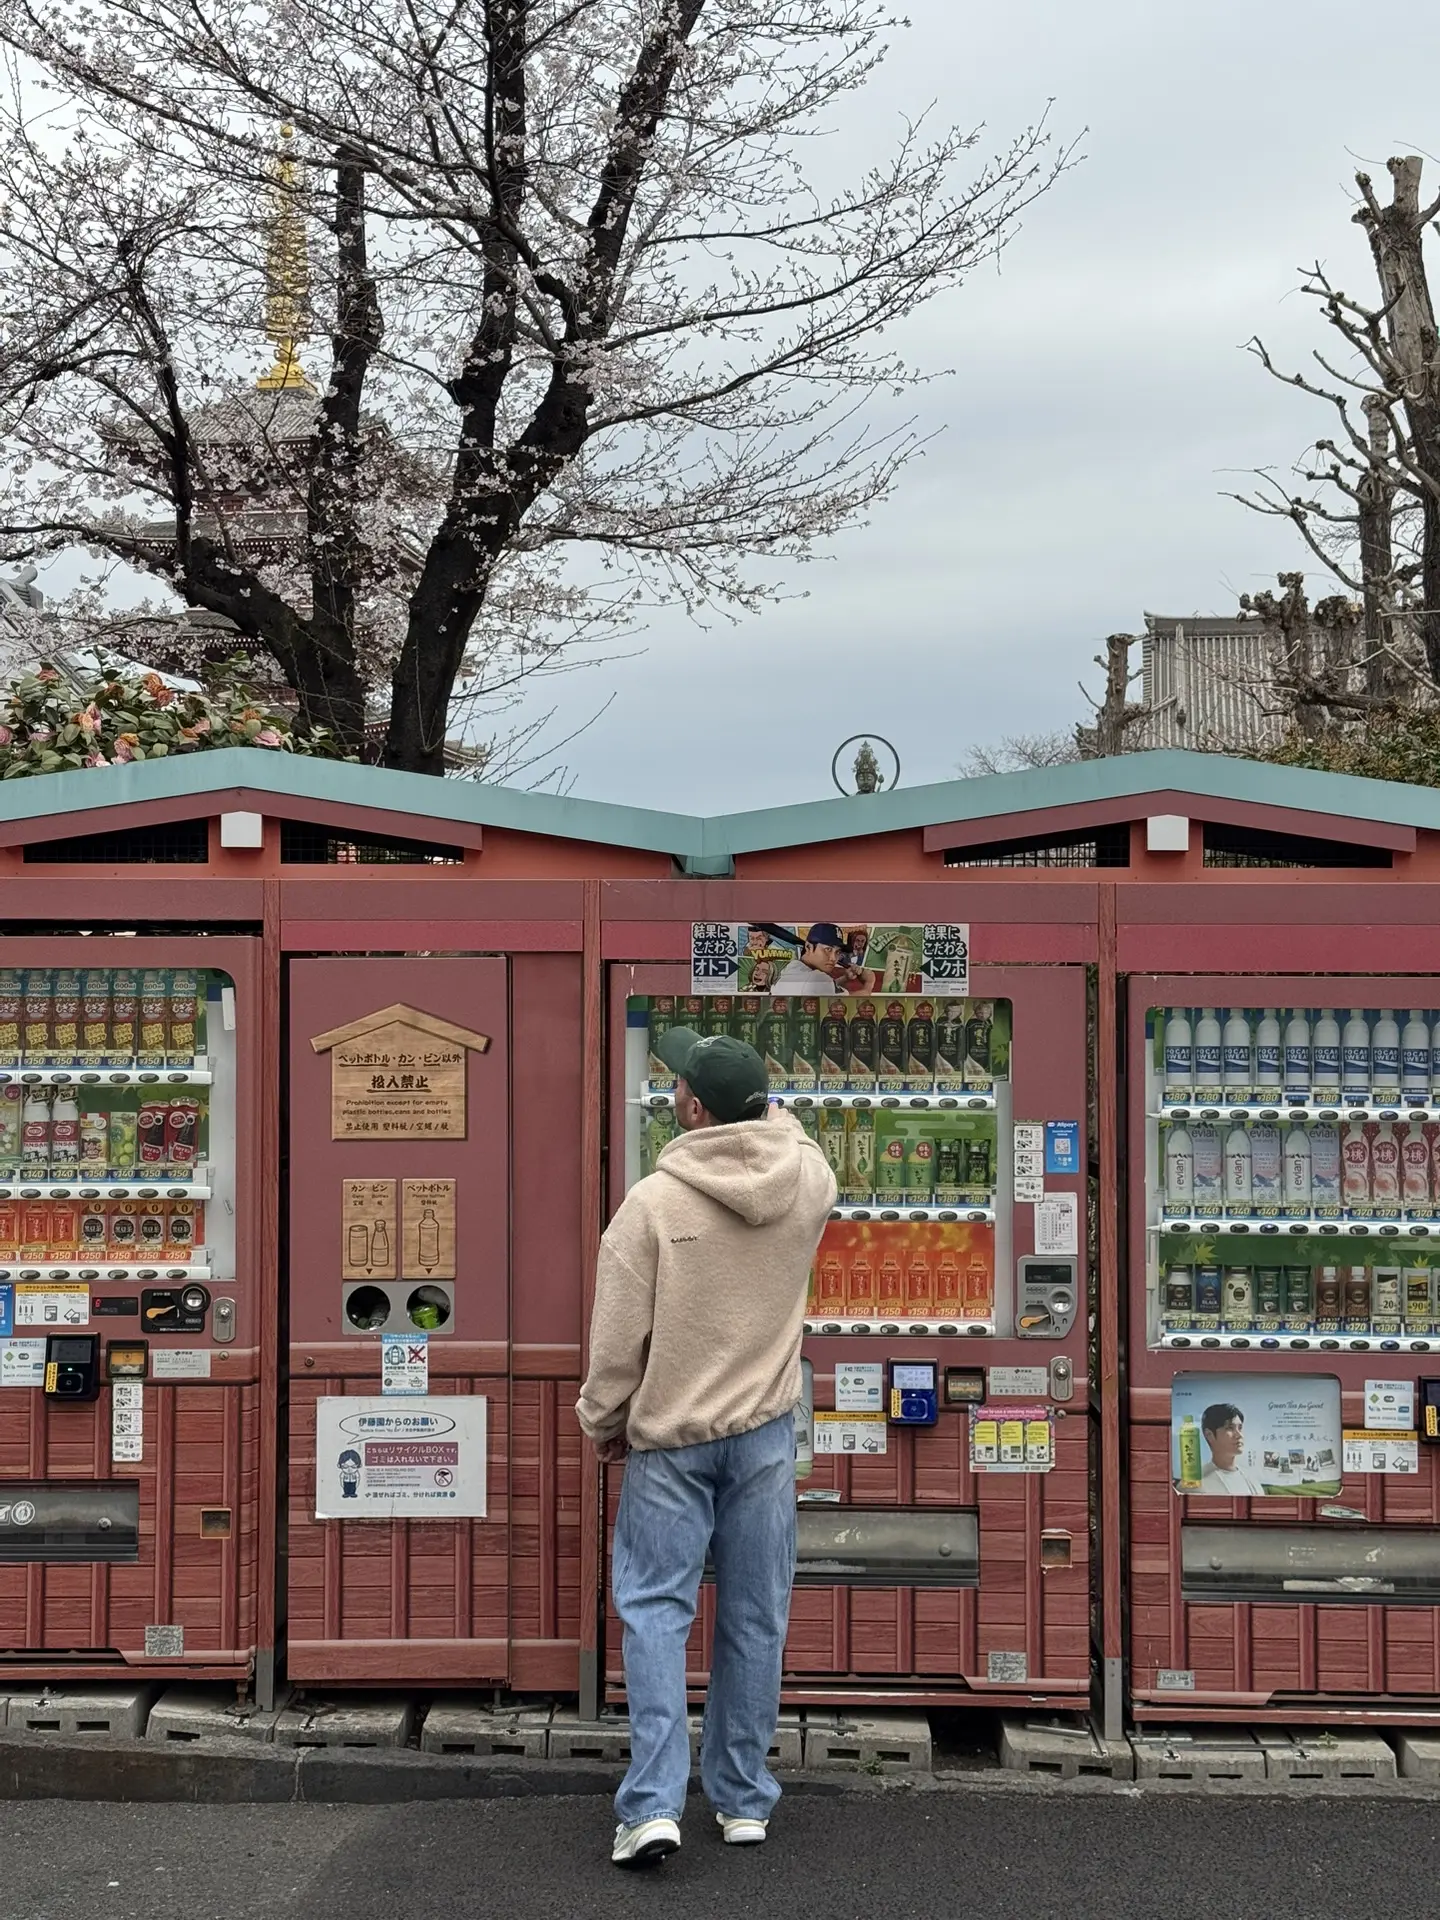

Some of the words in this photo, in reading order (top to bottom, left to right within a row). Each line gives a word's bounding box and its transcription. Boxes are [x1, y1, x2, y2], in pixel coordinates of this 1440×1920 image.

[694, 924, 729, 939] 結果に
[924, 925, 959, 940] 結果に
[694, 941, 735, 954] こだわる
[924, 942, 965, 956] こだわる
[695, 959, 729, 975] オトコ
[930, 960, 965, 977] トクホ
[338, 1053, 462, 1064] ペットボトル・カン・ビン以外
[371, 1075, 429, 1089] 投入禁止
[1191, 1128, 1218, 1138] evian
[1249, 1128, 1277, 1138] evian
[1309, 1128, 1337, 1139] evian
[1351, 1149, 1364, 1161] 桃
[1381, 1149, 1394, 1161] 桃
[1411, 1149, 1423, 1161] 桃
[1176, 1159, 1185, 1186] evian
[1234, 1159, 1243, 1186] evian
[1293, 1159, 1302, 1186] evian
[351, 1184, 366, 1193] カン
[372, 1184, 388, 1192] ビン
[407, 1184, 451, 1192] ペットボトル
[1383, 1300, 1394, 1309] 20
[1412, 1301, 1424, 1310] 90
[358, 1417, 438, 1427] 伊藤園からのお願い
